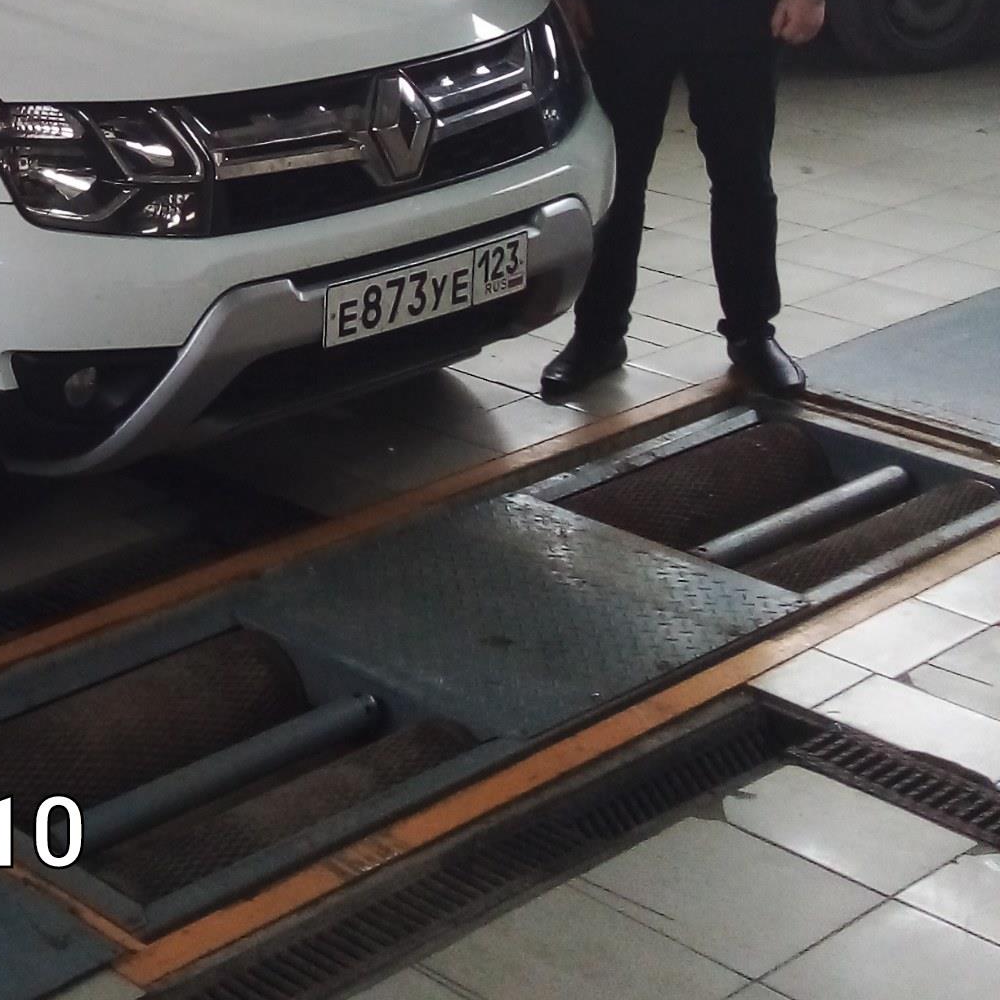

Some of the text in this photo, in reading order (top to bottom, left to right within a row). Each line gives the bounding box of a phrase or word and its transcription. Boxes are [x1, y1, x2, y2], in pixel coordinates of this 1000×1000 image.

[338, 239, 520, 338] Е873УЕ 123
[484, 278, 507, 295] RUS
